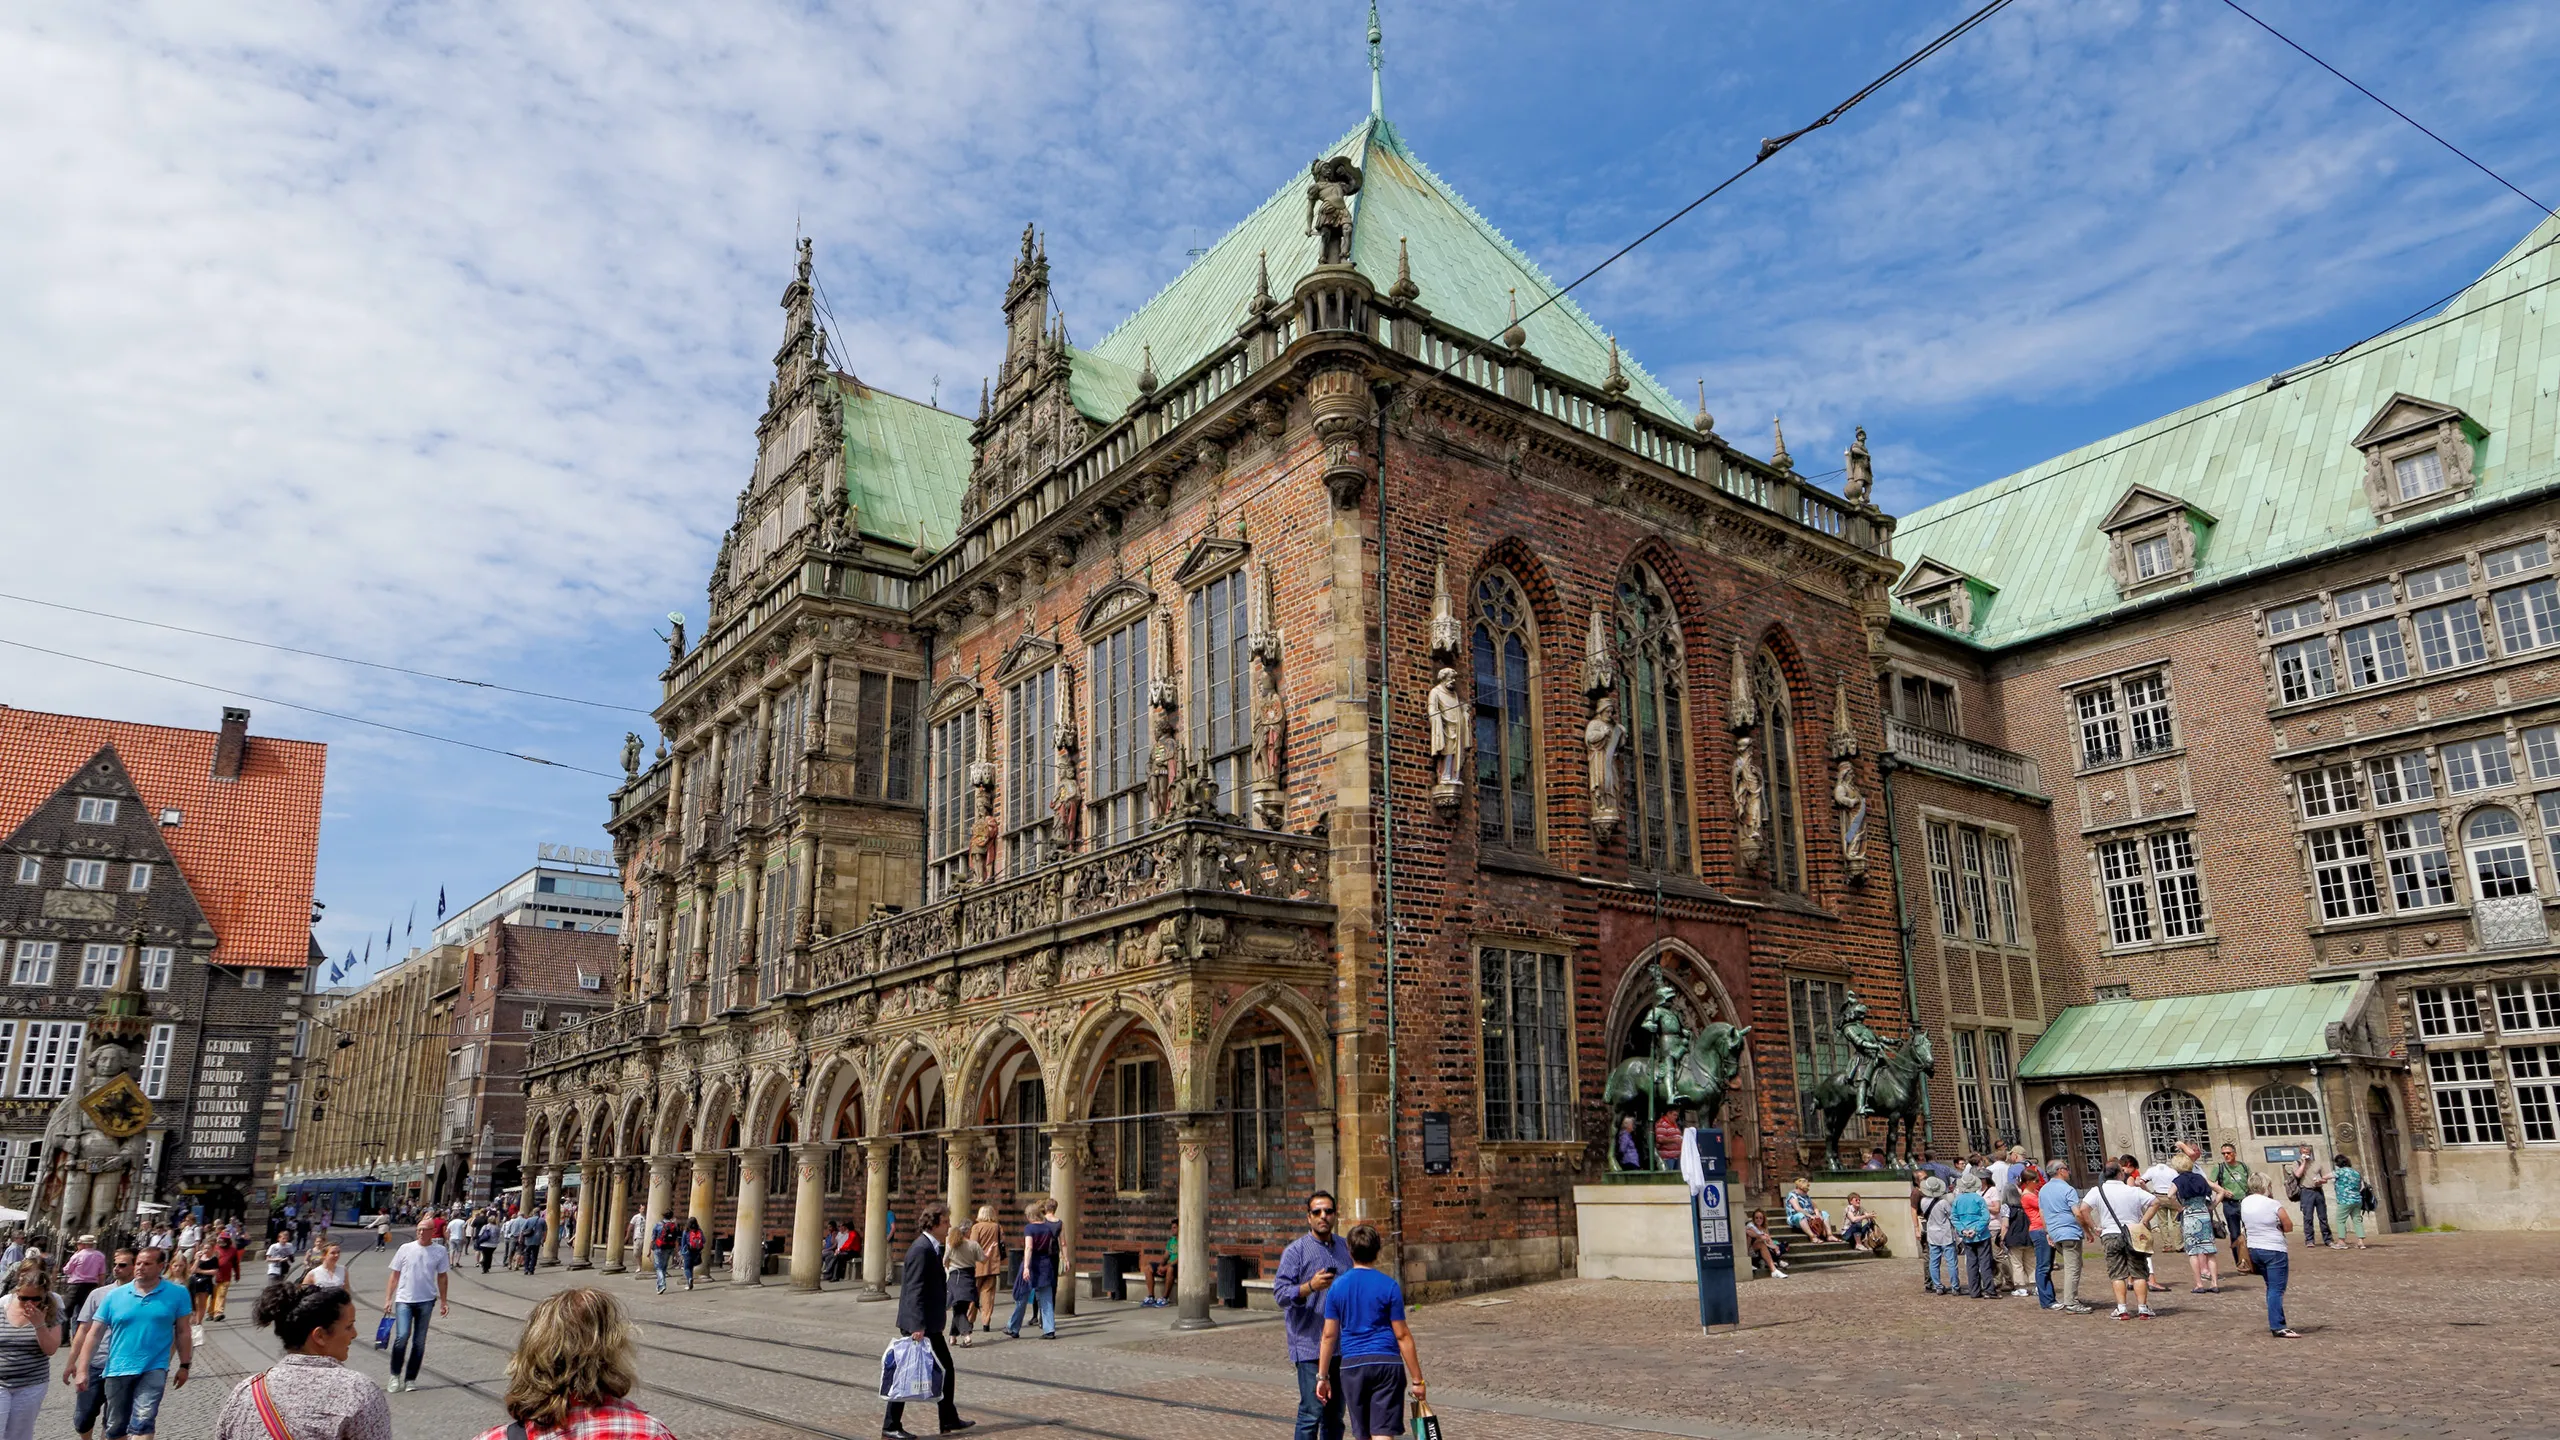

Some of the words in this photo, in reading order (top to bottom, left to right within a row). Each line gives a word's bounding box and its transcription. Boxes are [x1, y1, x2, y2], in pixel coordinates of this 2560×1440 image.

[538, 842, 619, 868] KARST
[205, 1040, 252, 1053] GEDENKE
[203, 1055, 225, 1067] DER
[198, 1085, 217, 1098] DIE
[218, 1085, 239, 1098] DAS
[195, 1100, 250, 1113] SCHICKSAL
[193, 1115, 242, 1128] UNSERER
[191, 1131, 247, 1143] TRENNUNG
